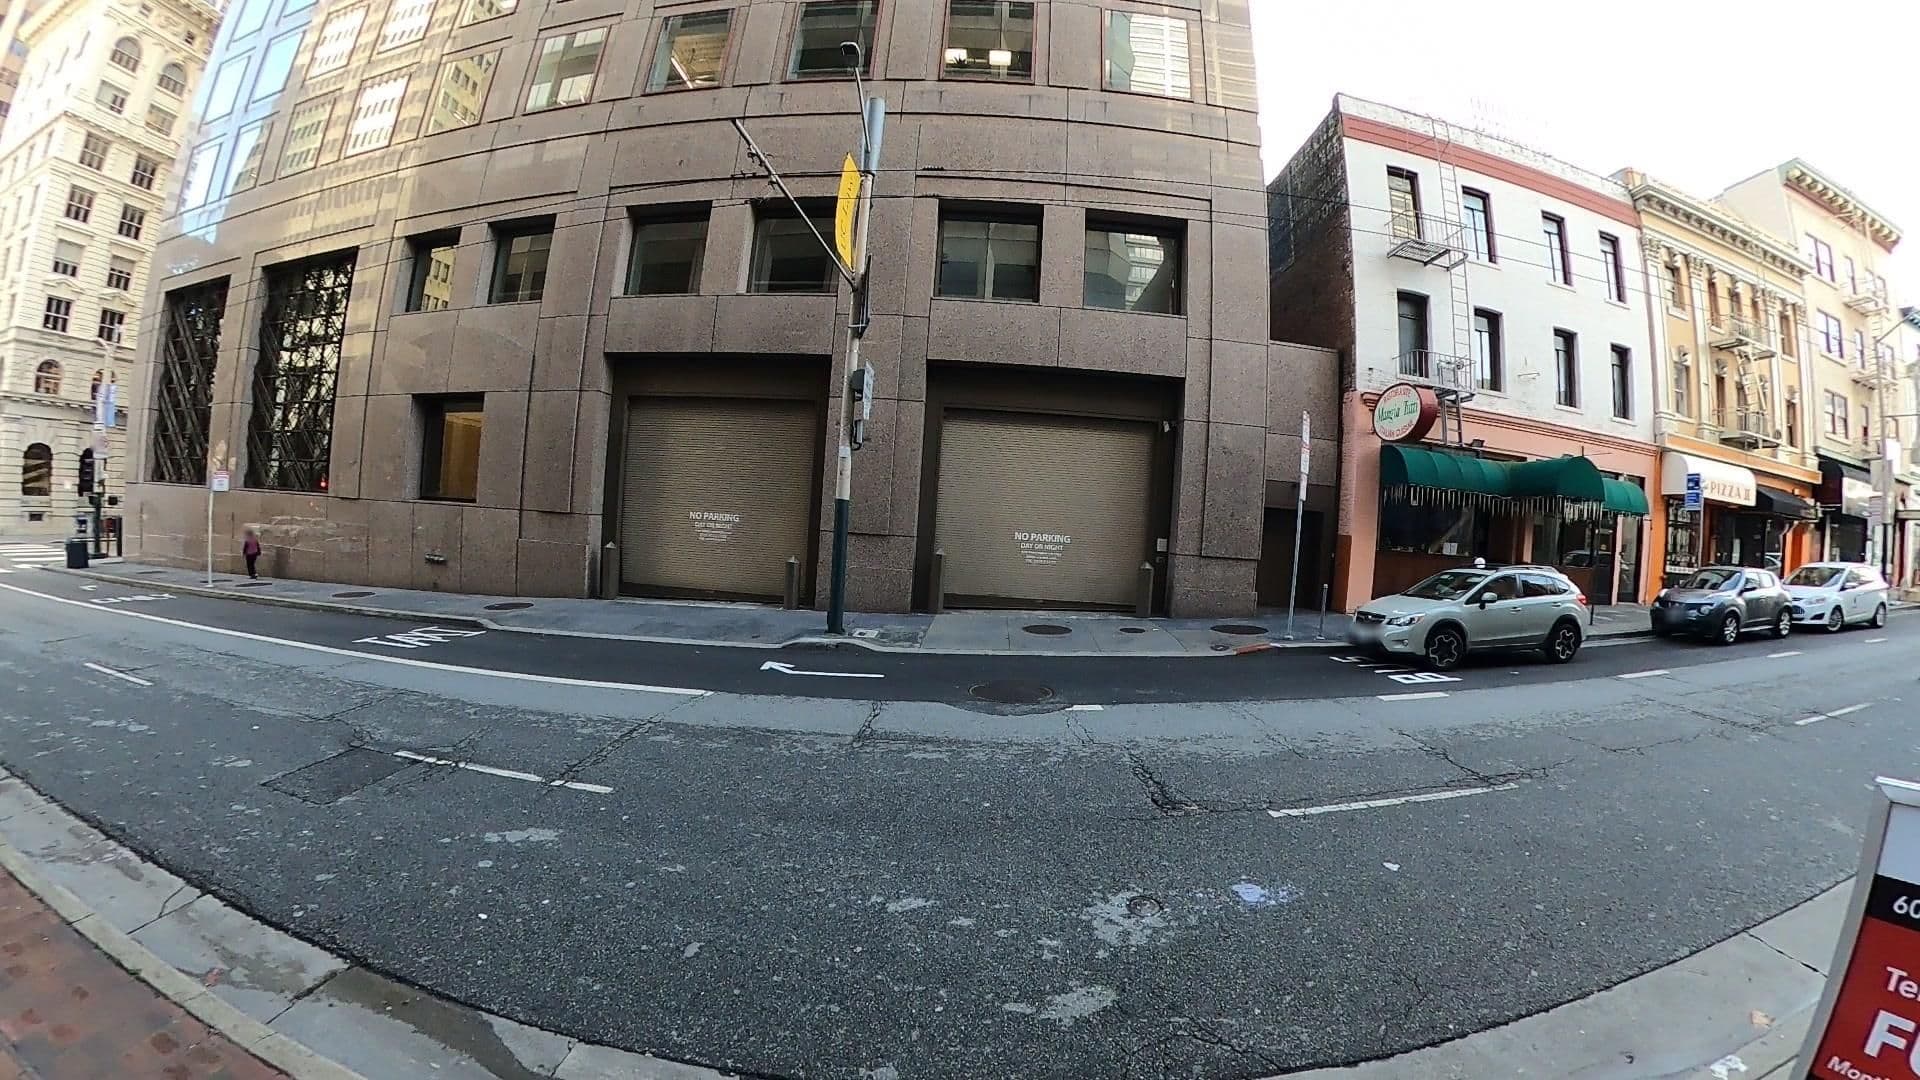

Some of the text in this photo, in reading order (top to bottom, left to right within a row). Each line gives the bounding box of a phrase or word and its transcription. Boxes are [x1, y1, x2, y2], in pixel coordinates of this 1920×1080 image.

[1710, 480, 1741, 499] PIZZA
[689, 511, 740, 522] NO PARKING
[1014, 531, 1072, 544] NO PARKING
[351, 625, 487, 649] TAXI
